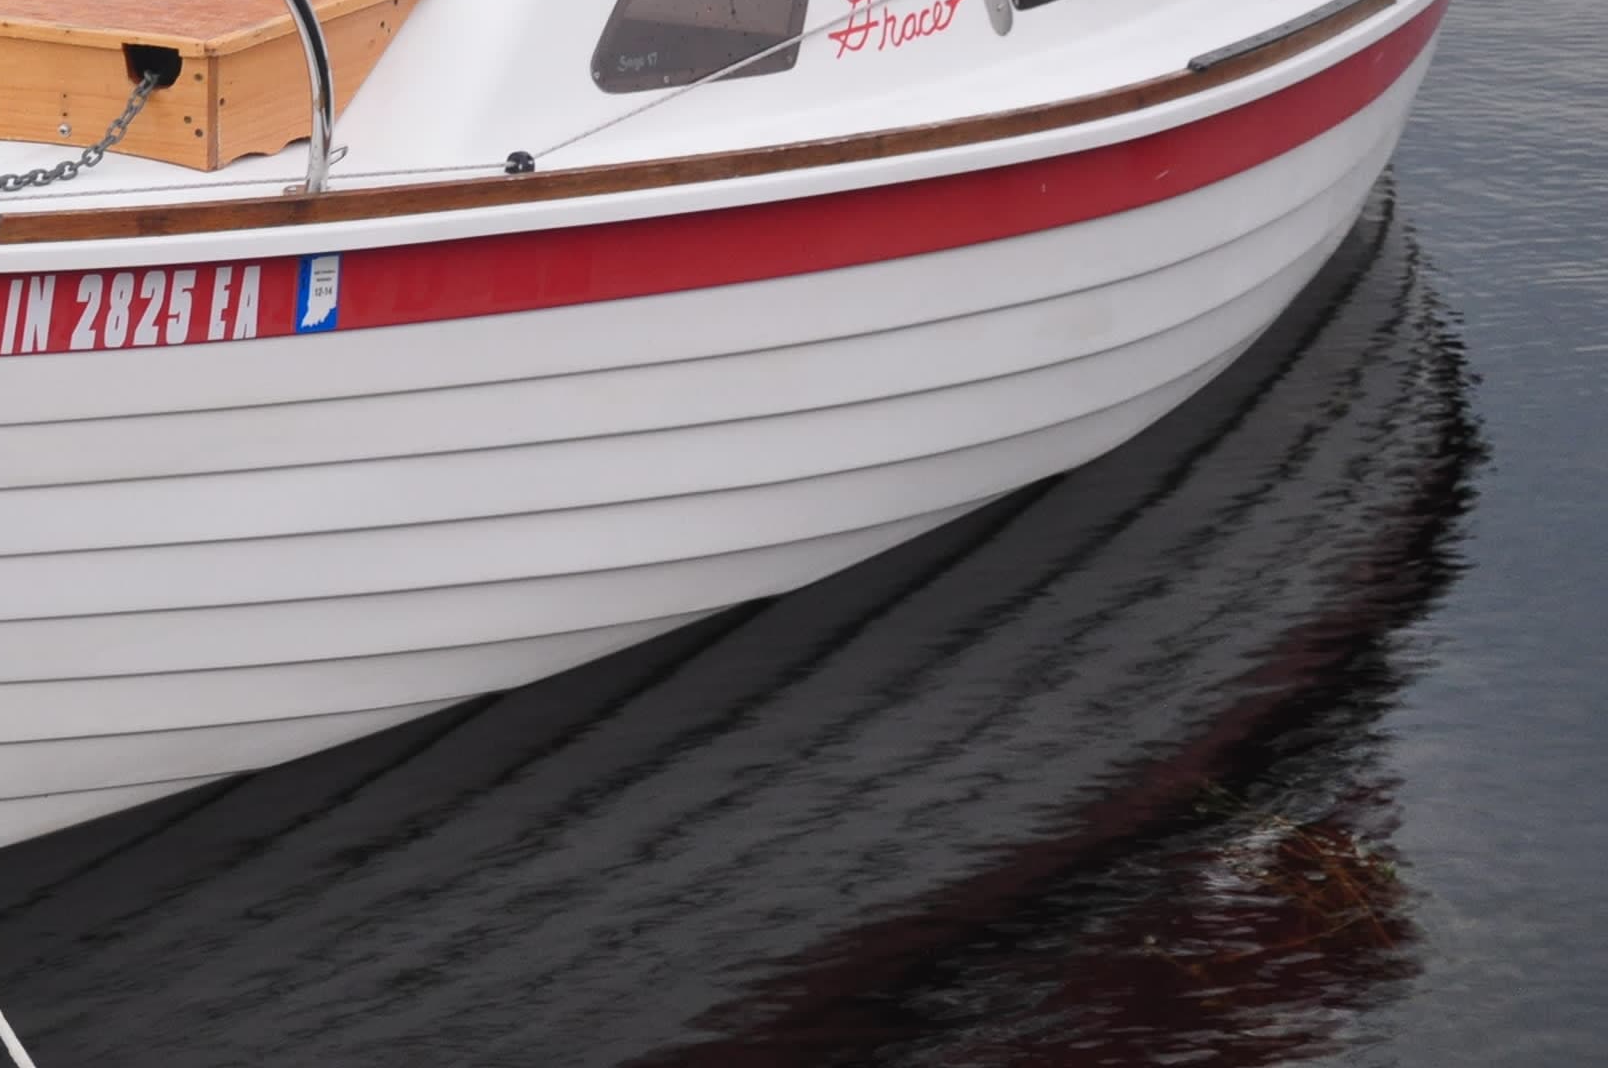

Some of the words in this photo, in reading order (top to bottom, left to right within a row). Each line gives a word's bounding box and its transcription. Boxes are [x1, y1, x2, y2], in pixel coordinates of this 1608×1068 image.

[0, 275, 56, 355] IN
[69, 269, 196, 351] 2825
[207, 265, 261, 341] EA
